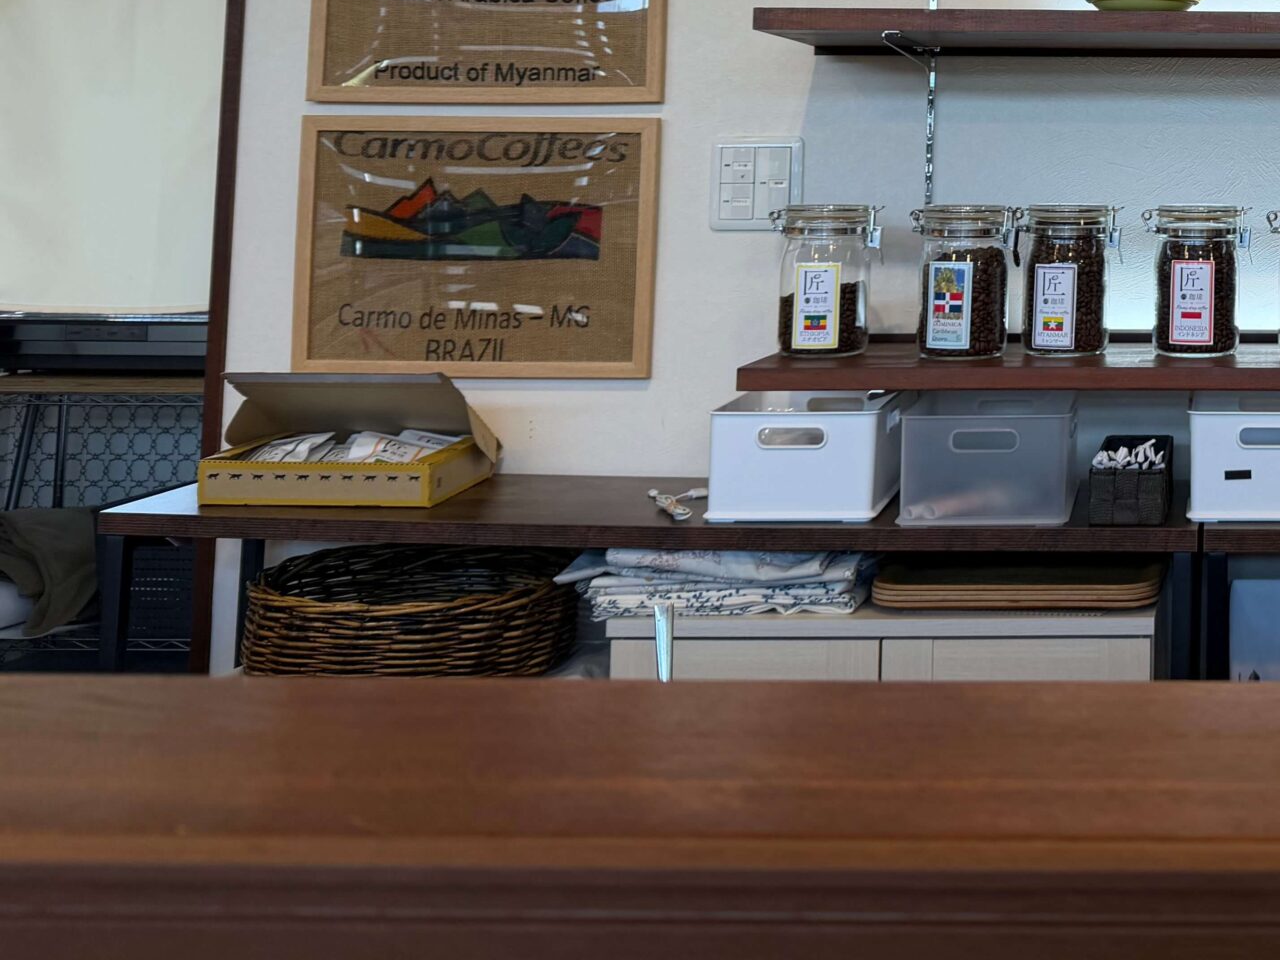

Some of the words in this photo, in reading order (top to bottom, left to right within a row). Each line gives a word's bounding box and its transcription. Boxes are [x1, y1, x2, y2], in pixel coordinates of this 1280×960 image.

[374, 61, 458, 82] Product
[466, 61, 490, 82] of
[494, 62, 600, 86] Myanmar
[338, 304, 411, 329] Carmo
[419, 305, 446, 330] de
[454, 308, 522, 331] Minas
[550, 304, 590, 328] MG
